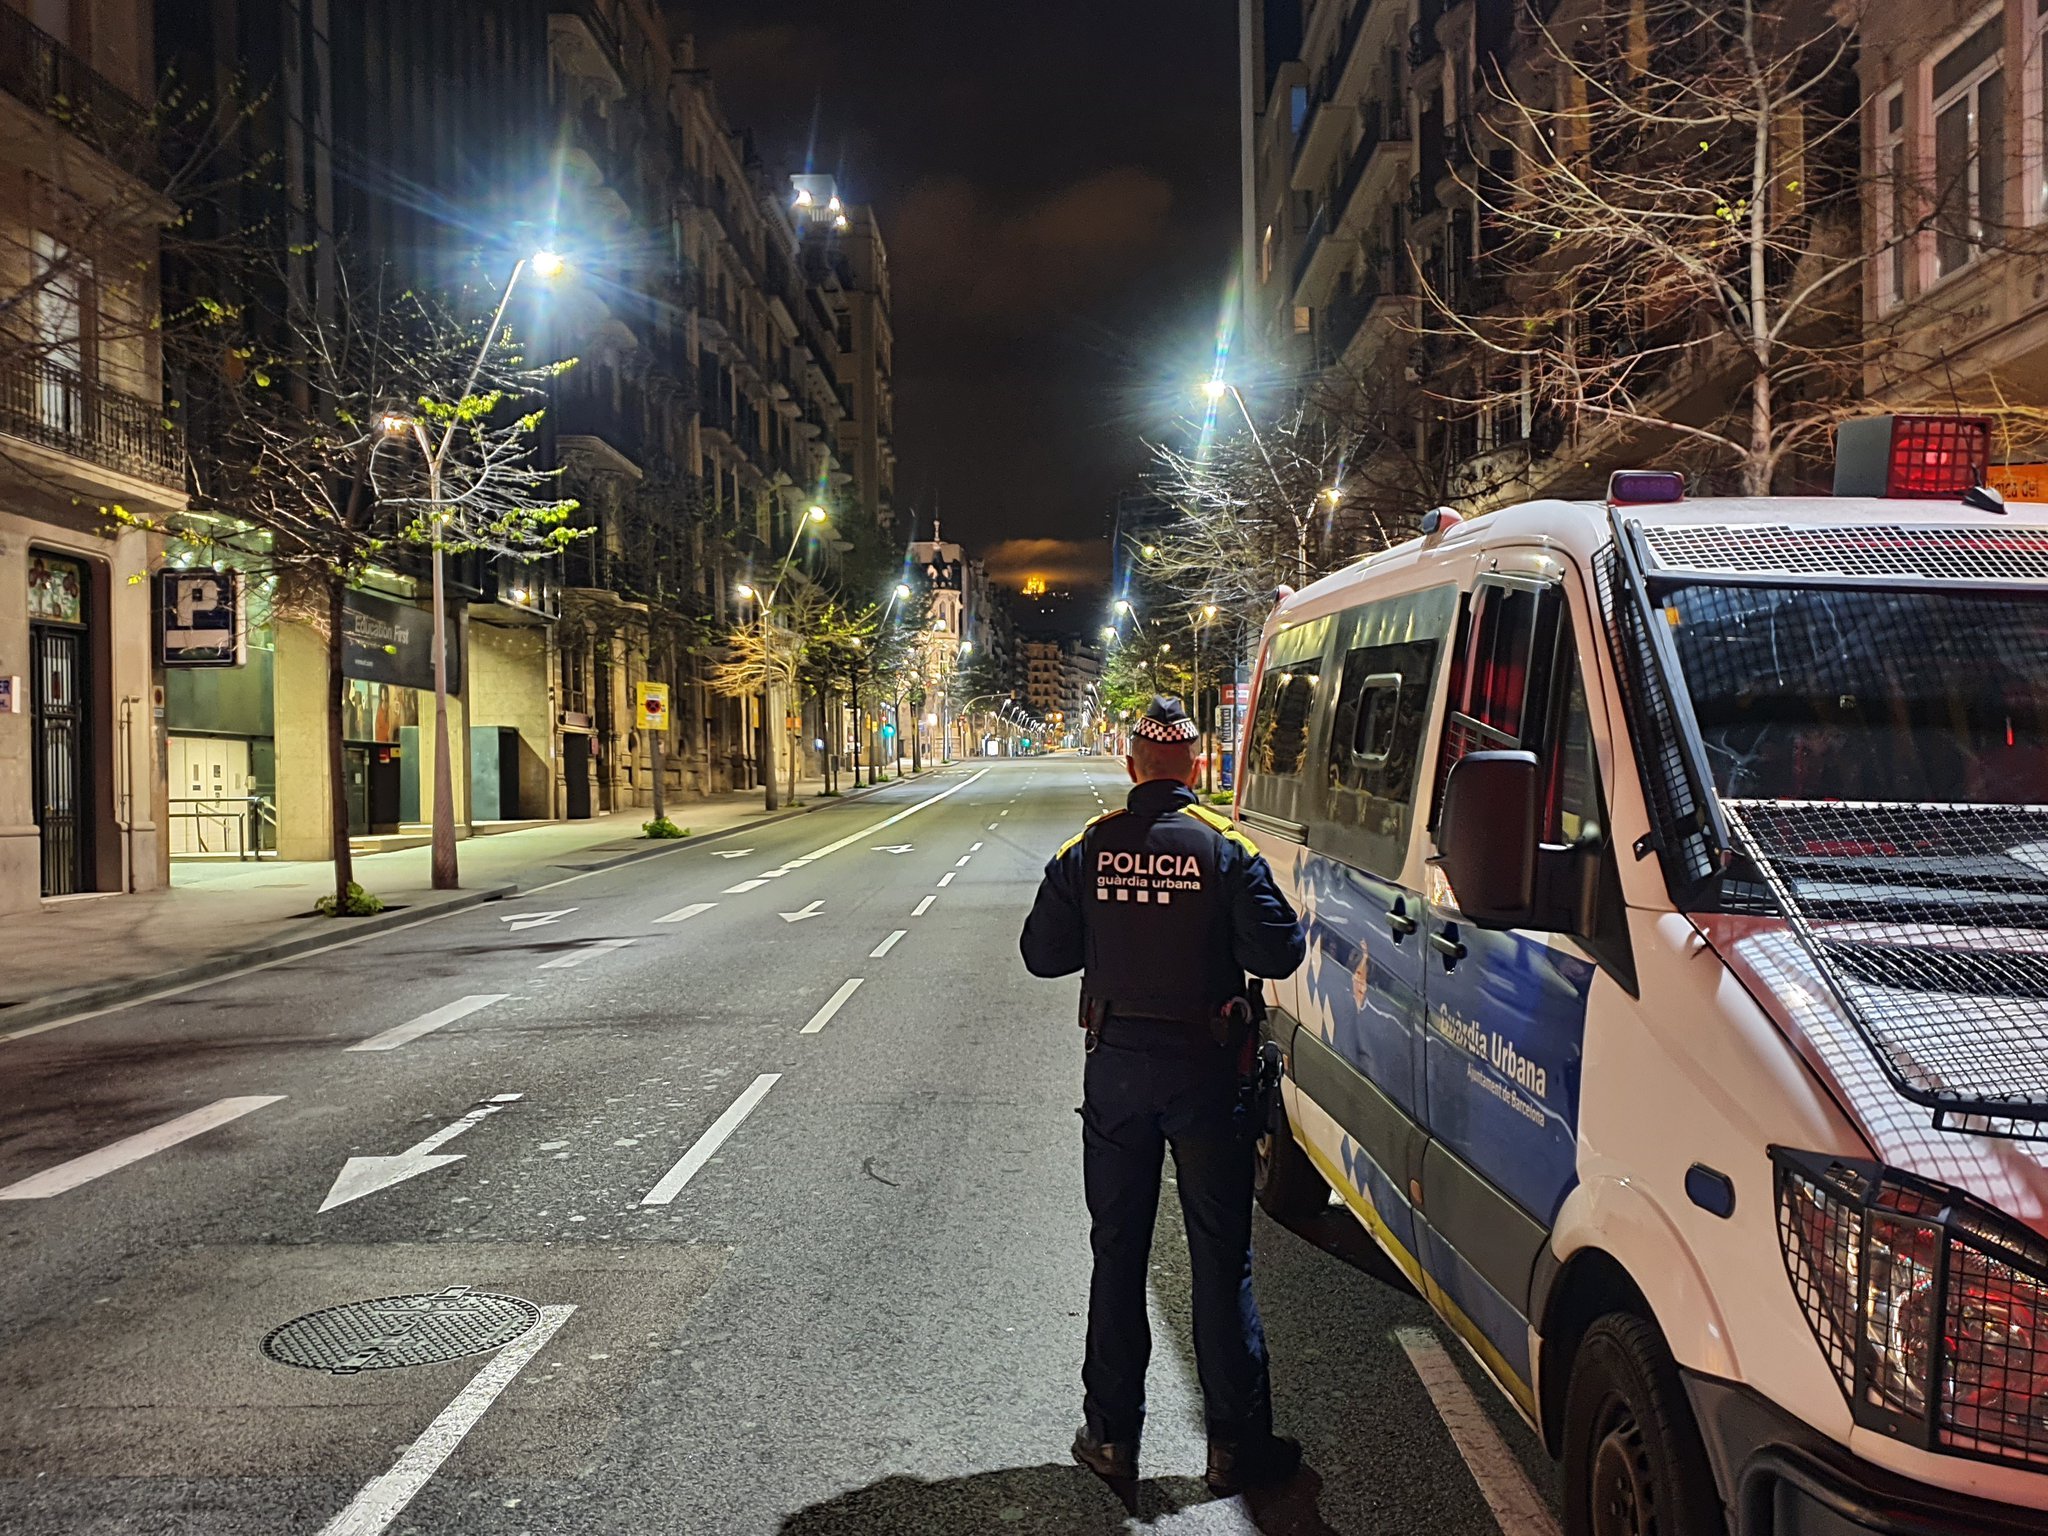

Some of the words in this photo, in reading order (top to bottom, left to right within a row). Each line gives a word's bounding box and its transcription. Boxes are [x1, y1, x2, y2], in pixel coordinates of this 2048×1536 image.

[178, 579, 218, 627] P
[355, 615, 393, 640] Education
[394, 624, 410, 645] First
[1097, 851, 1201, 877] POLICIA
[1097, 875, 1148, 887] guàrdia
[1152, 878, 1201, 890] urbana
[1439, 1002, 1488, 1061] Guàrdia
[1492, 1031, 1547, 1099] Urbana
[1467, 1062, 1503, 1098] Ajuntament
[1503, 1085, 1512, 1105] de
[1511, 1090, 1546, 1128] Barcelona
